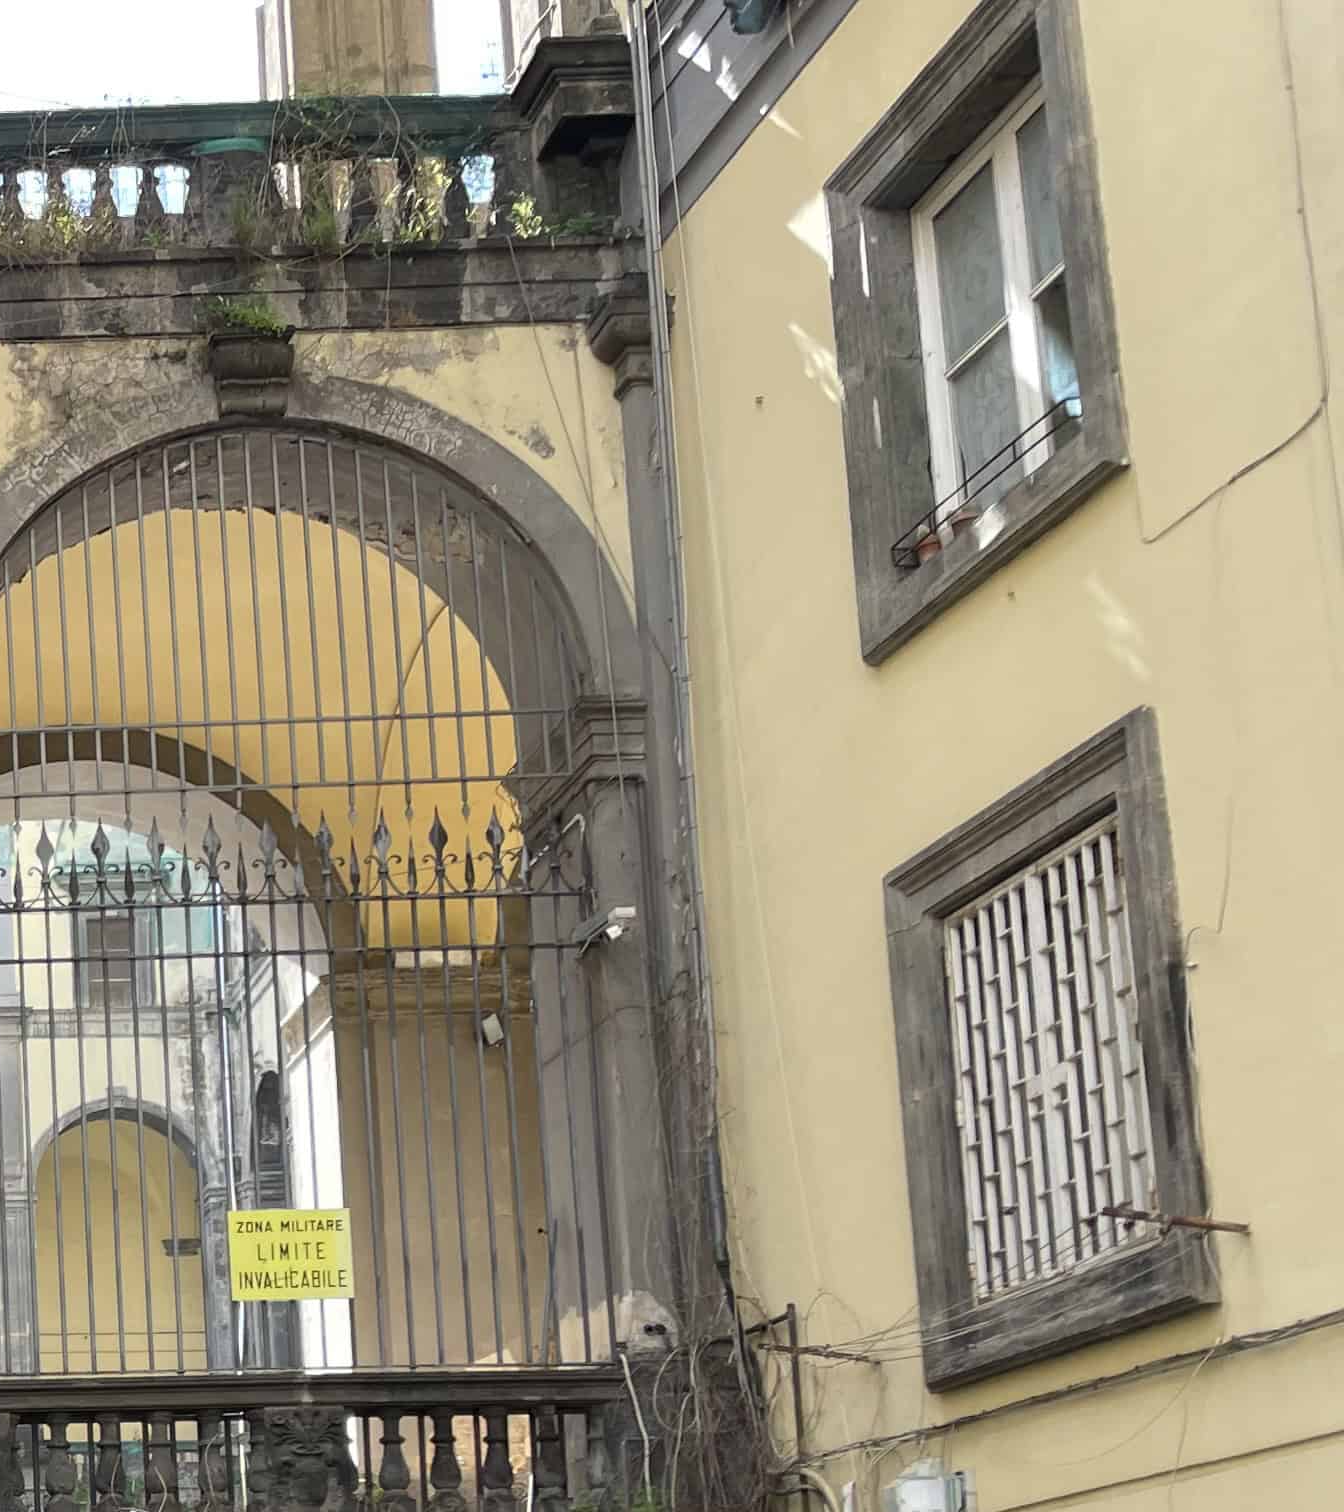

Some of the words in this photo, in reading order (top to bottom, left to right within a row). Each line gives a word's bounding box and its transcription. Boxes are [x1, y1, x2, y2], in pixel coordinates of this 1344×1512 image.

[236, 1221, 273, 1234] ZONA
[280, 1219, 345, 1233] MILITARE
[257, 1241, 327, 1262] LIMITE
[239, 1269, 348, 1290] INVALICABILE
